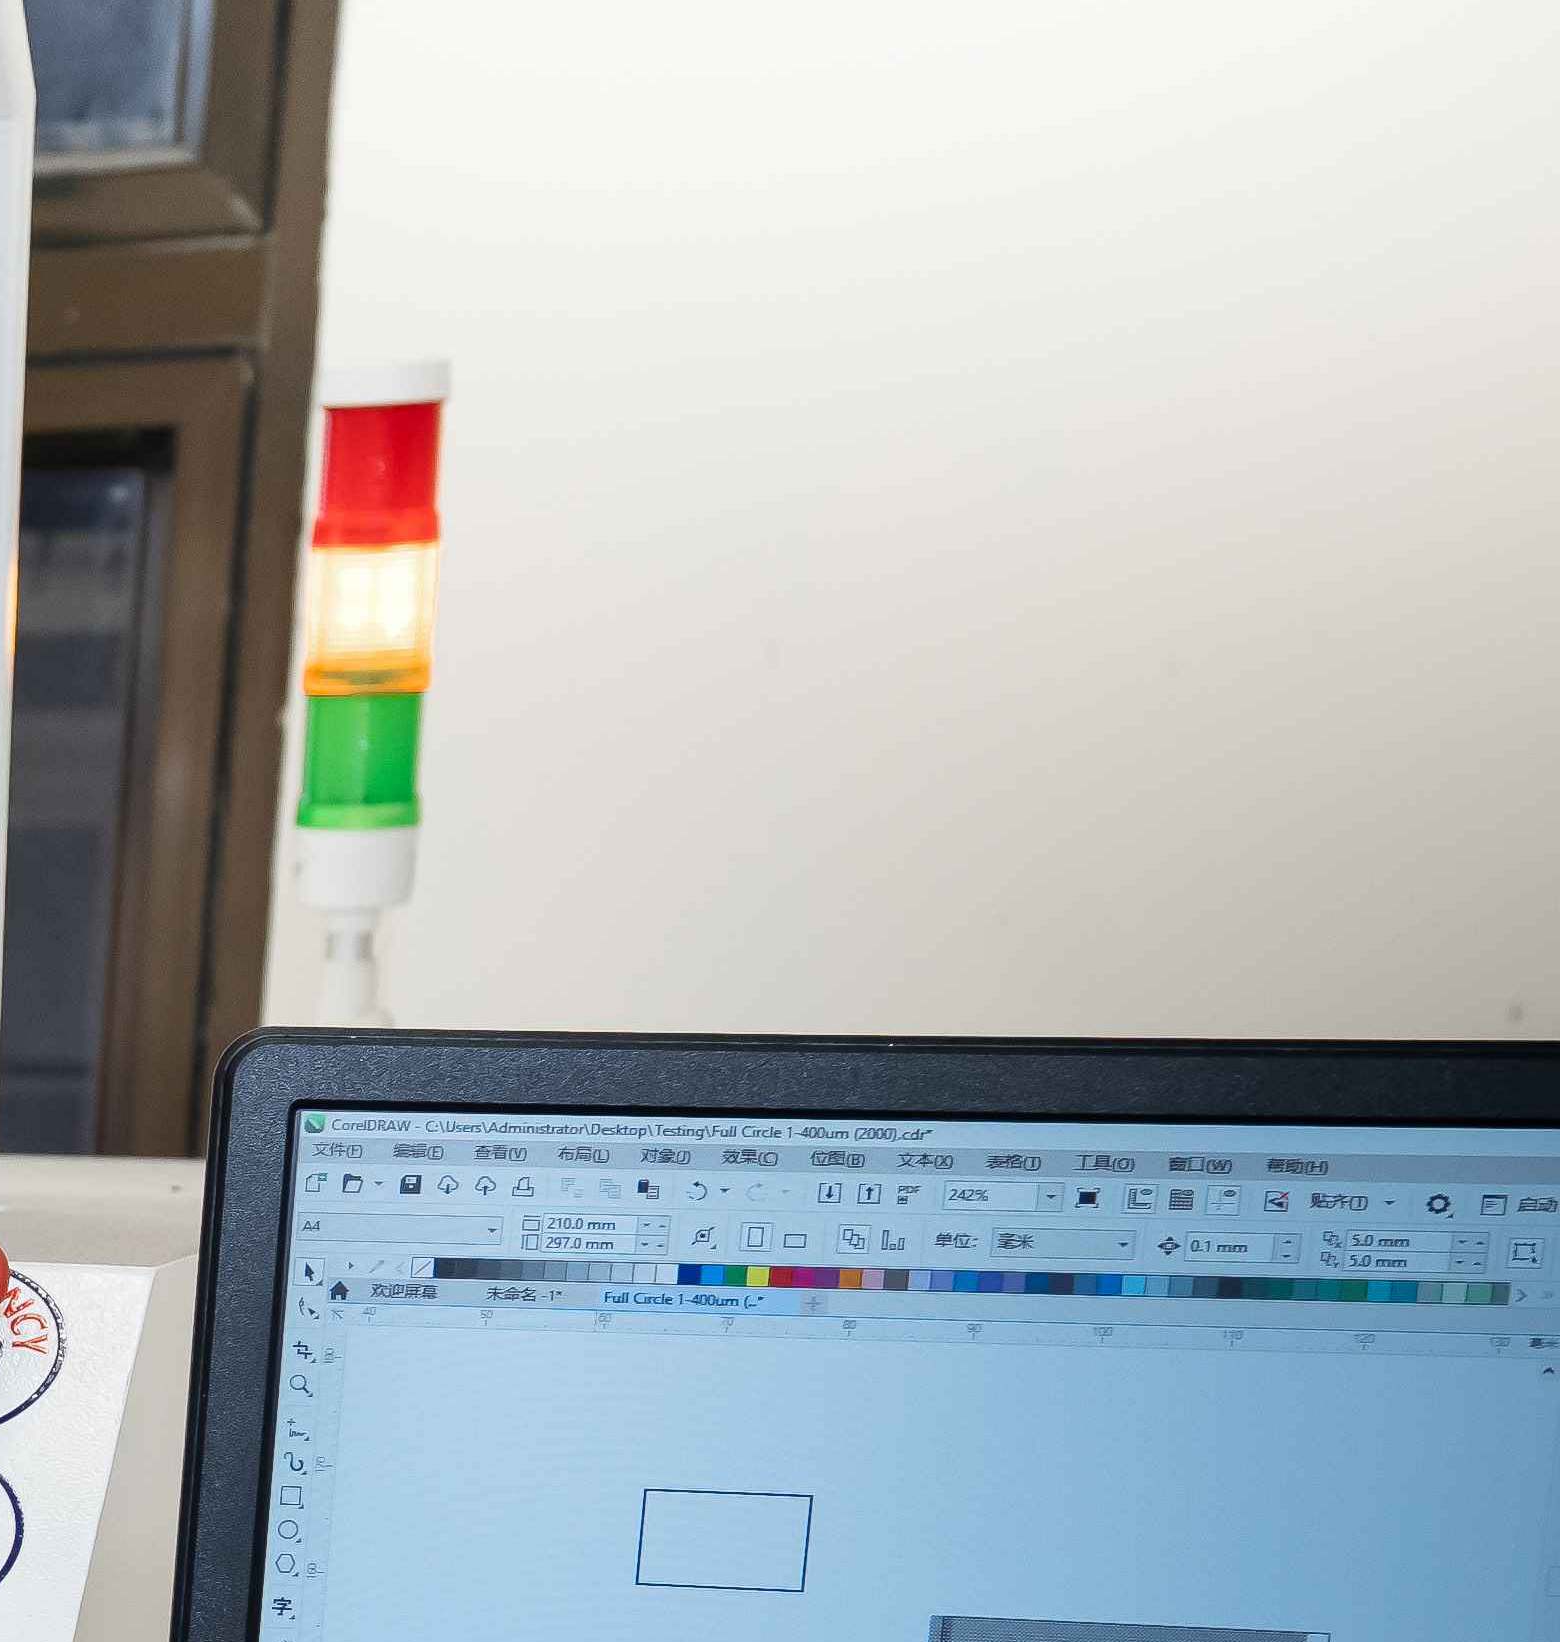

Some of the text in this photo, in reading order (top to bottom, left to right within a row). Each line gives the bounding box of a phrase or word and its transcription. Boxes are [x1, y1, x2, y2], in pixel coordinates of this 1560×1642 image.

[331, 1118, 411, 1134] CorelDRAW
[425, 1119, 737, 1140] C:\Users\Administrator\Desktop\Testing\Full
[742, 1125, 782, 1139] Circle
[787, 1126, 849, 1140] 1-400um
[311, 1142, 363, 1160] 文件(F)
[474, 1144, 528, 1162] 查看(V)
[558, 1146, 610, 1164] 布局(L)
[640, 1147, 691, 1165] 对象(J)
[721, 1149, 778, 1167] 效果(C)
[896, 1152, 954, 1170] 文本(X)
[1073, 1154, 1136, 1173] 工具(O)
[1168, 1156, 1233, 1175] 窗口(W)
[948, 1187, 989, 1203] 242%
[302, 1219, 321, 1233] A4
[546, 1217, 617, 1232] 210.0 mm
[545, 1236, 615, 1251] 297.0 mm
[996, 1232, 1034, 1250] 毫米
[1190, 1239, 1248, 1255] 0.1 mm
[1352, 1233, 1410, 1248] 5.0 mm
[1348, 1254, 1408, 1269] 5.0 mm
[370, 1283, 439, 1301] 欢迎屏幕
[486, 1286, 537, 1303] 未命名
[604, 1291, 631, 1304] Full
[634, 1292, 674, 1306] Circle
[677, 1293, 740, 1308] 1-400um
